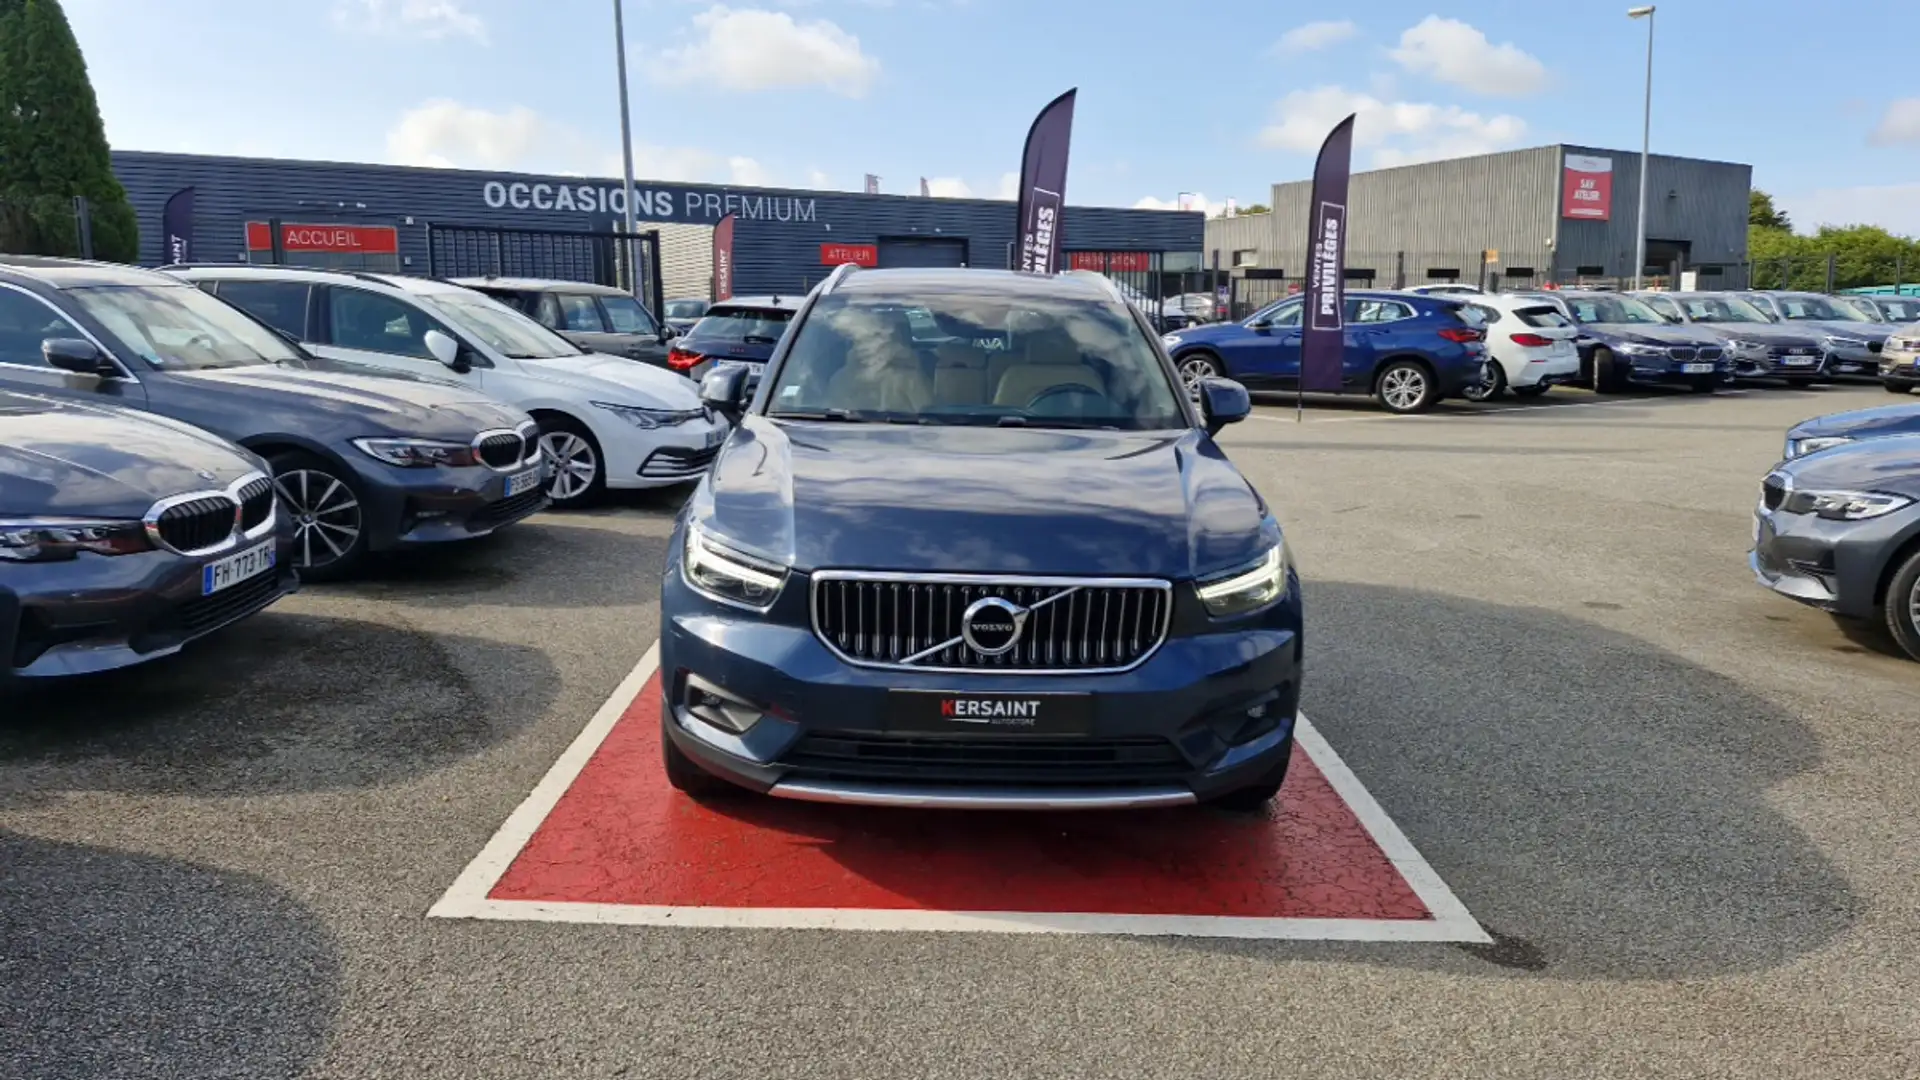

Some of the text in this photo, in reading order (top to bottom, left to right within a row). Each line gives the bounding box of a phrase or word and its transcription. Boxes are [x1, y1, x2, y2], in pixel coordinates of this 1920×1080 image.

[483, 181, 817, 222] OCCASIONS PREMIUM
[286, 230, 363, 247] ACCUEIL
[827, 248, 870, 261] ATELIER
[1311, 242, 1323, 288] VENTES
[1320, 218, 1339, 316] PRIVILÈGES
[971, 623, 1013, 632] VOLVO
[942, 700, 1041, 717] KERSAINT
